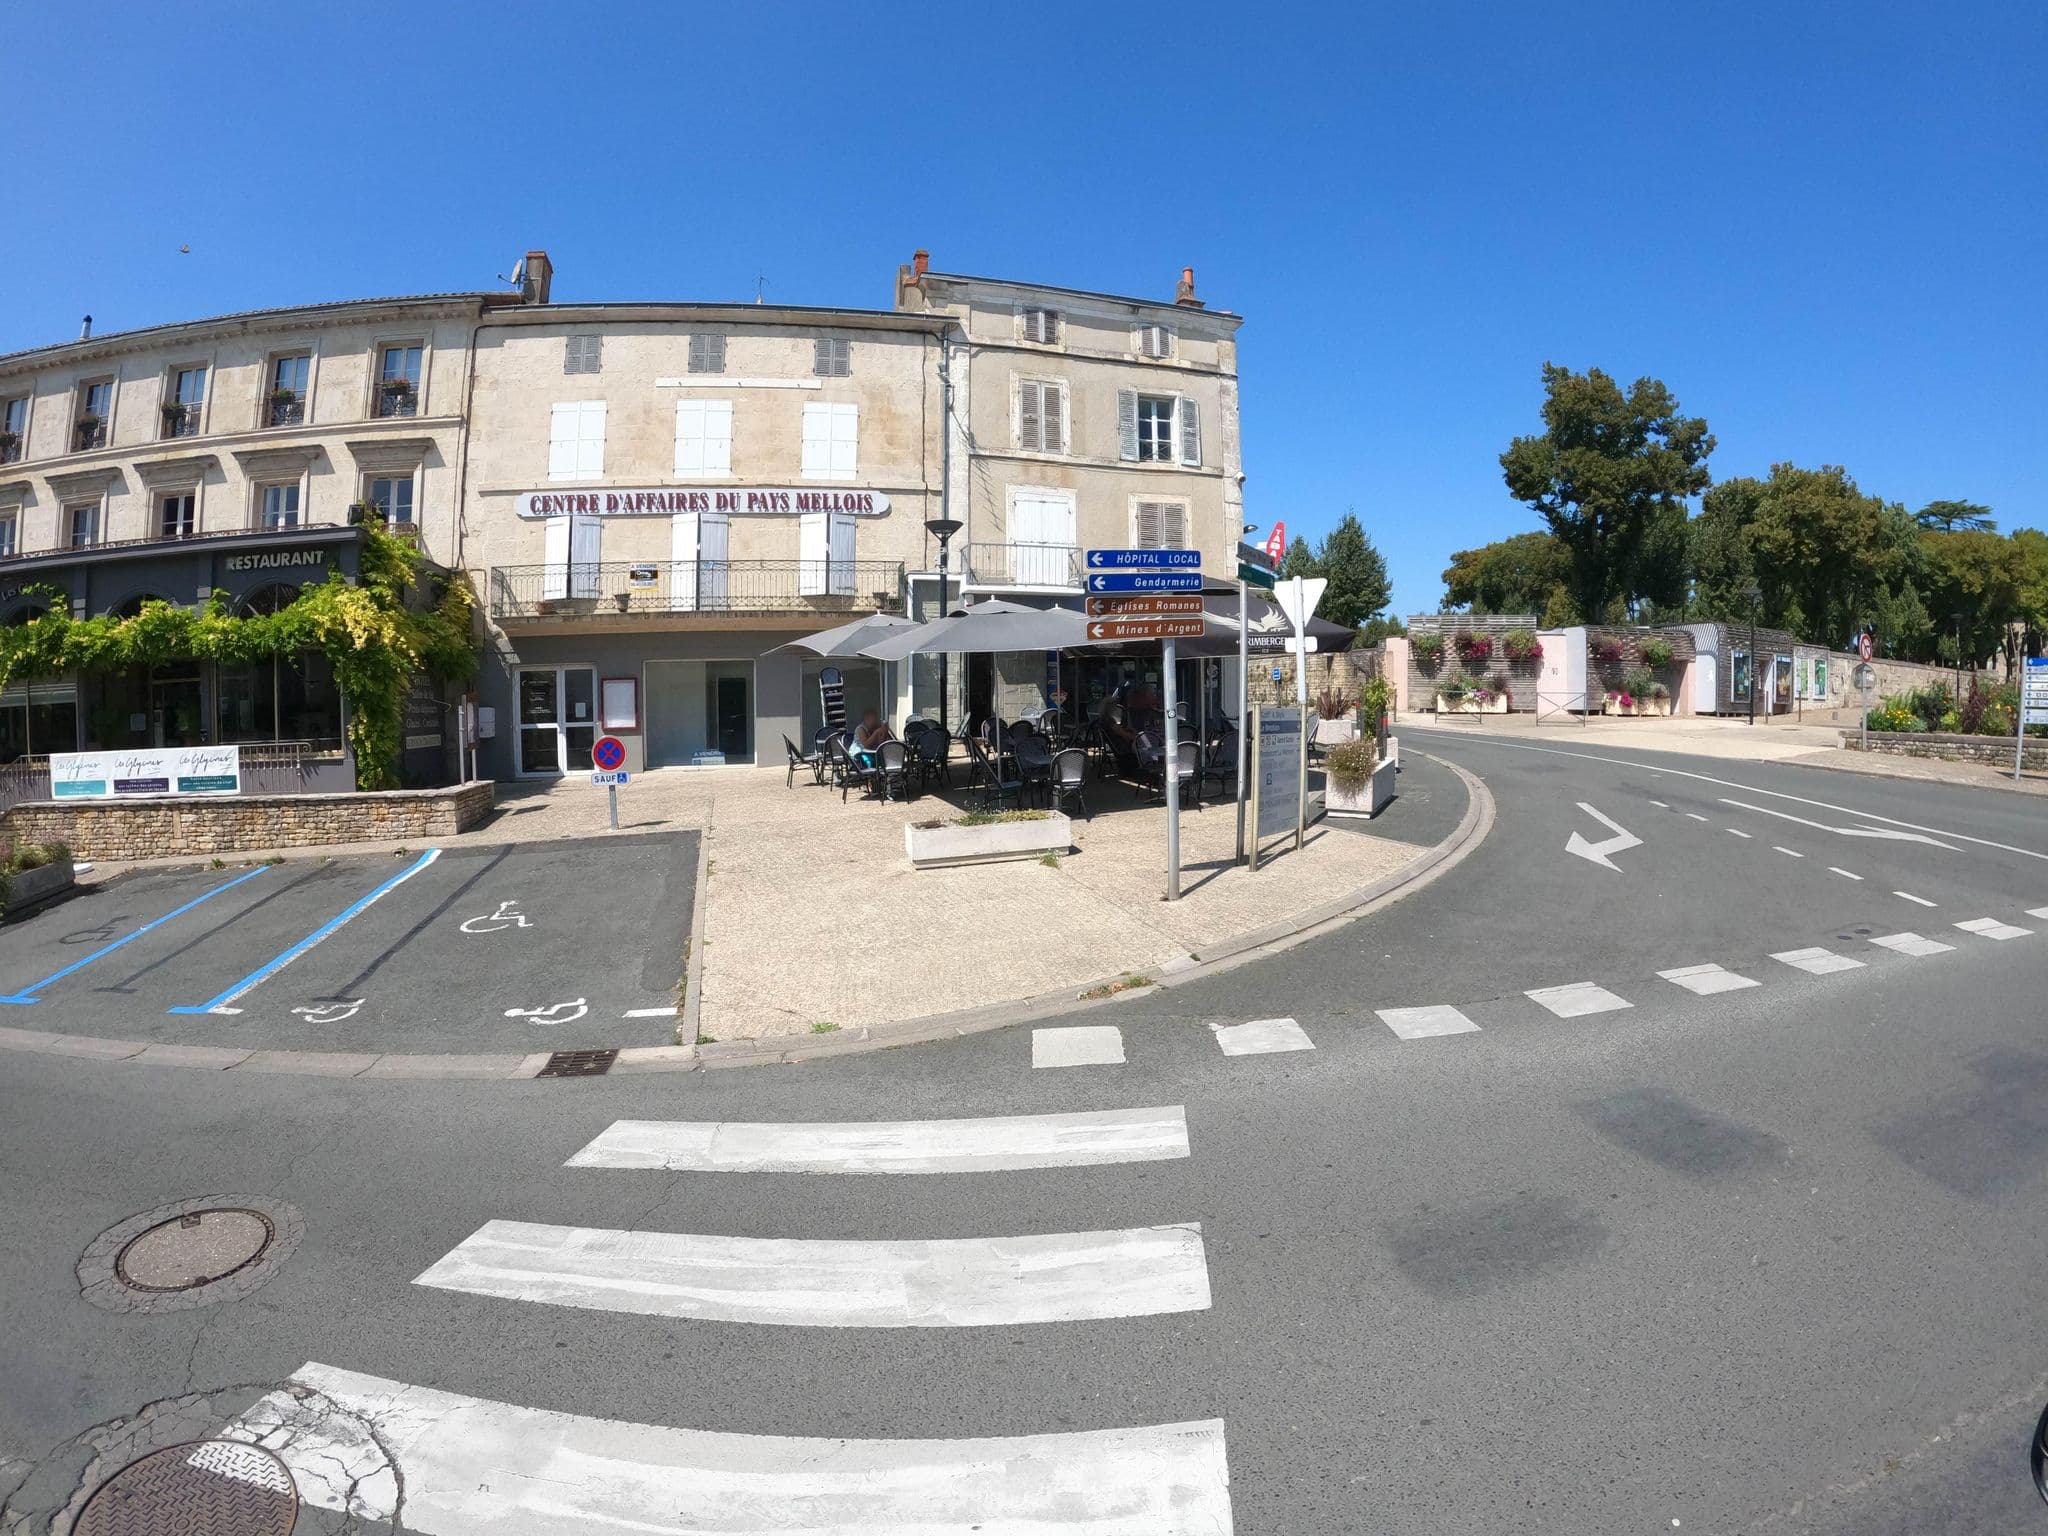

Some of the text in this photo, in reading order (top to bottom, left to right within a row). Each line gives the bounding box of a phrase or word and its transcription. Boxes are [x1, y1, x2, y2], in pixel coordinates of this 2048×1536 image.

[530, 492, 874, 515] CENTRE D'AFFAIRES DU PAYS MELLOIS
[225, 550, 324, 571] RESTAURANT
[1116, 552, 1200, 564] HÔPITAL LOCAL
[1134, 577, 1200, 587] Gendarmerie
[1156, 600, 1200, 611] Romanes
[1116, 623, 1201, 635] Mines d'Argent
[1246, 637, 1286, 646] RIMBERGE
[594, 774, 617, 784] SAUF
